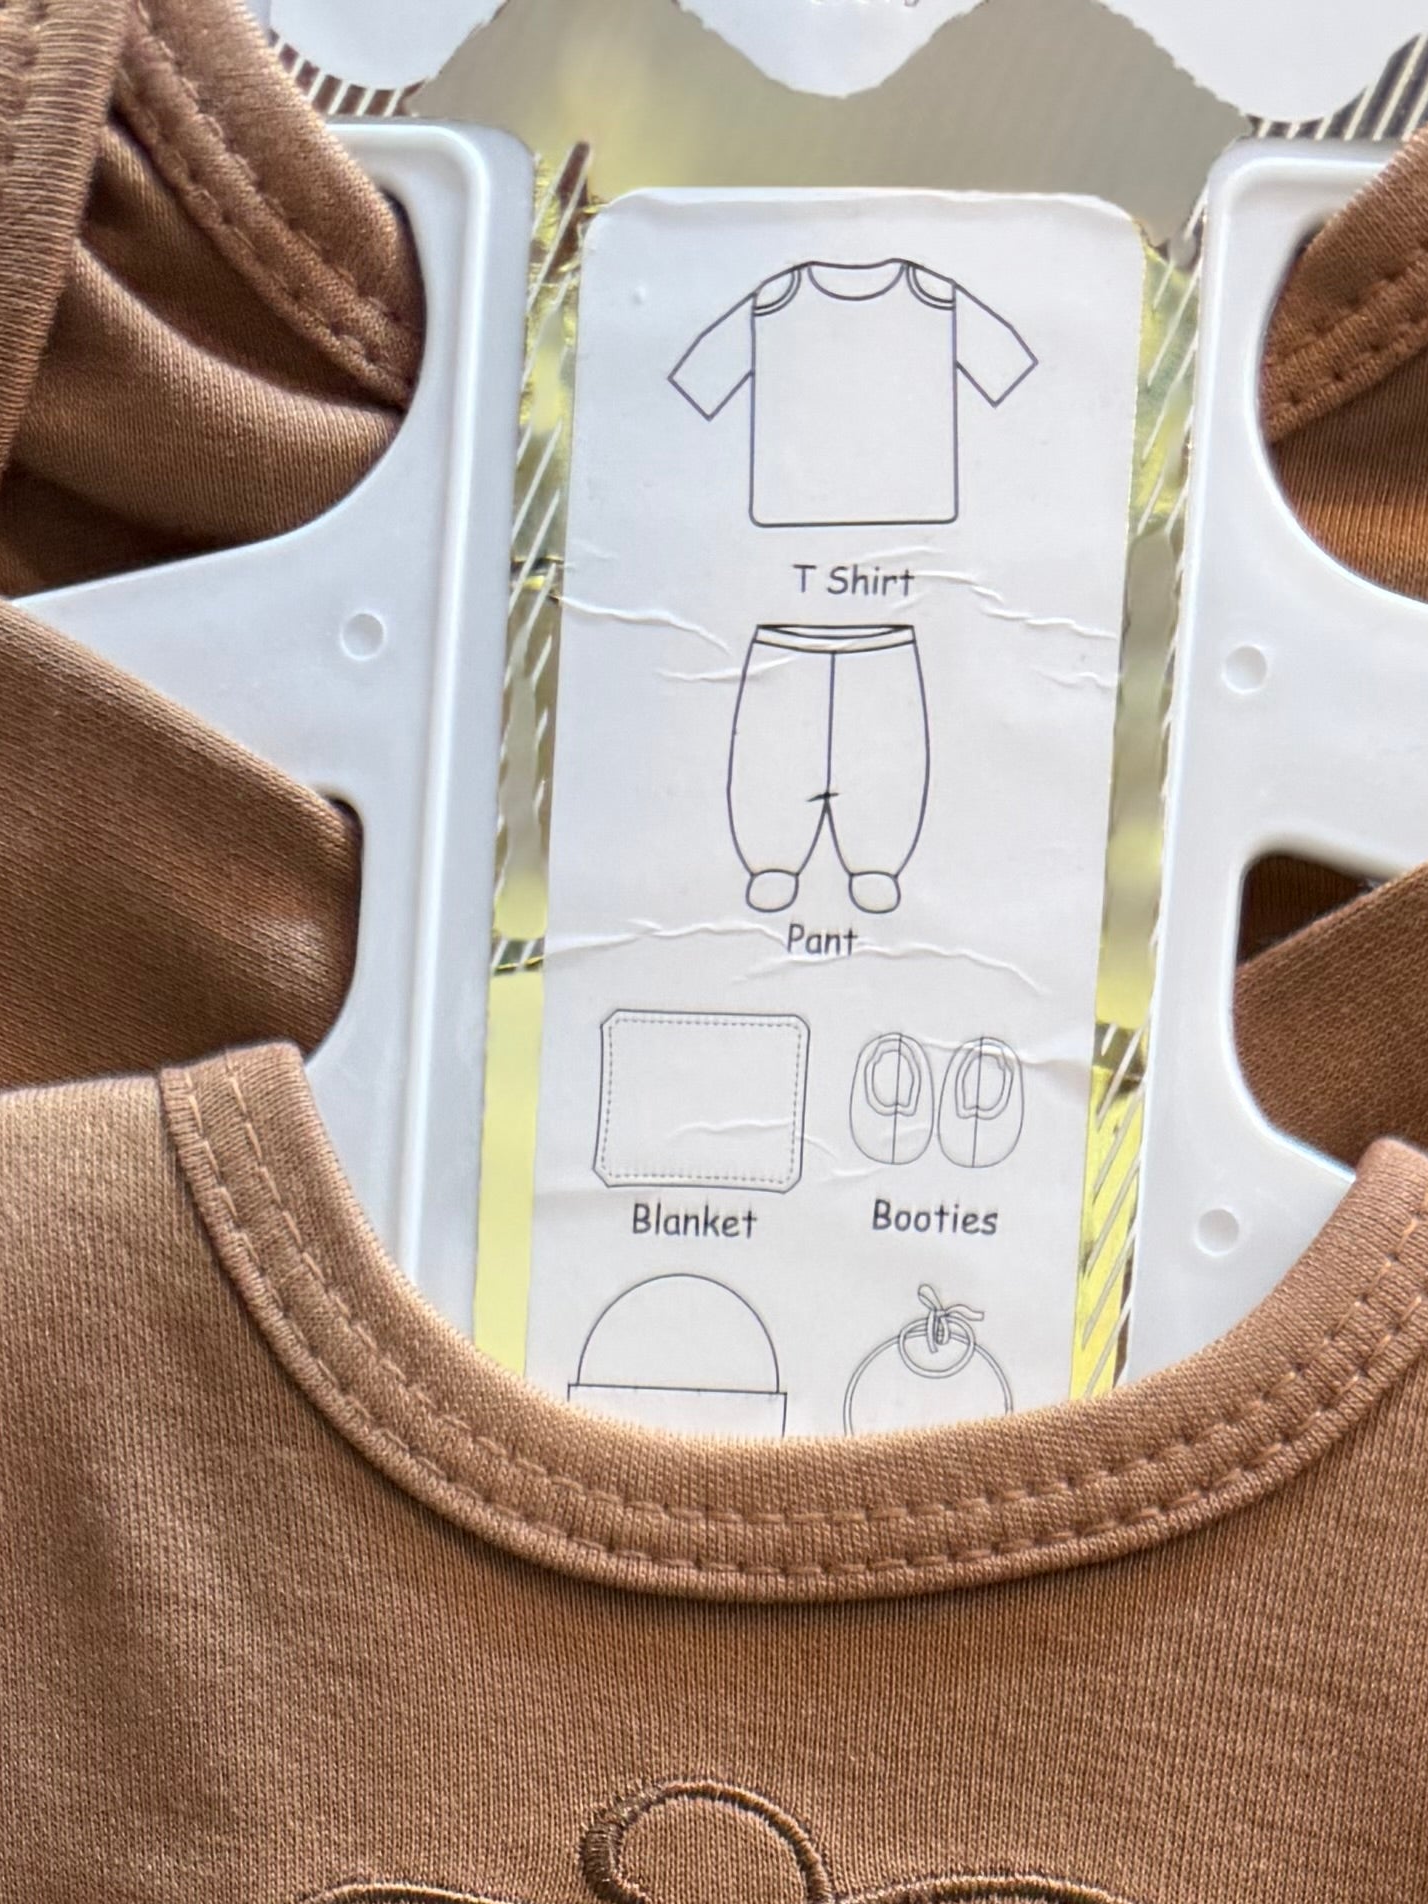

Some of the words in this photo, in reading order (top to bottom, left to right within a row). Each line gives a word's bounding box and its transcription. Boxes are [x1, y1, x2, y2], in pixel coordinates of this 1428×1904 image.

[792, 563, 817, 597] T
[828, 563, 915, 600] Shirt
[785, 924, 859, 957] Pant
[631, 1200, 758, 1240] Blanket
[871, 1196, 999, 1236] Booties
